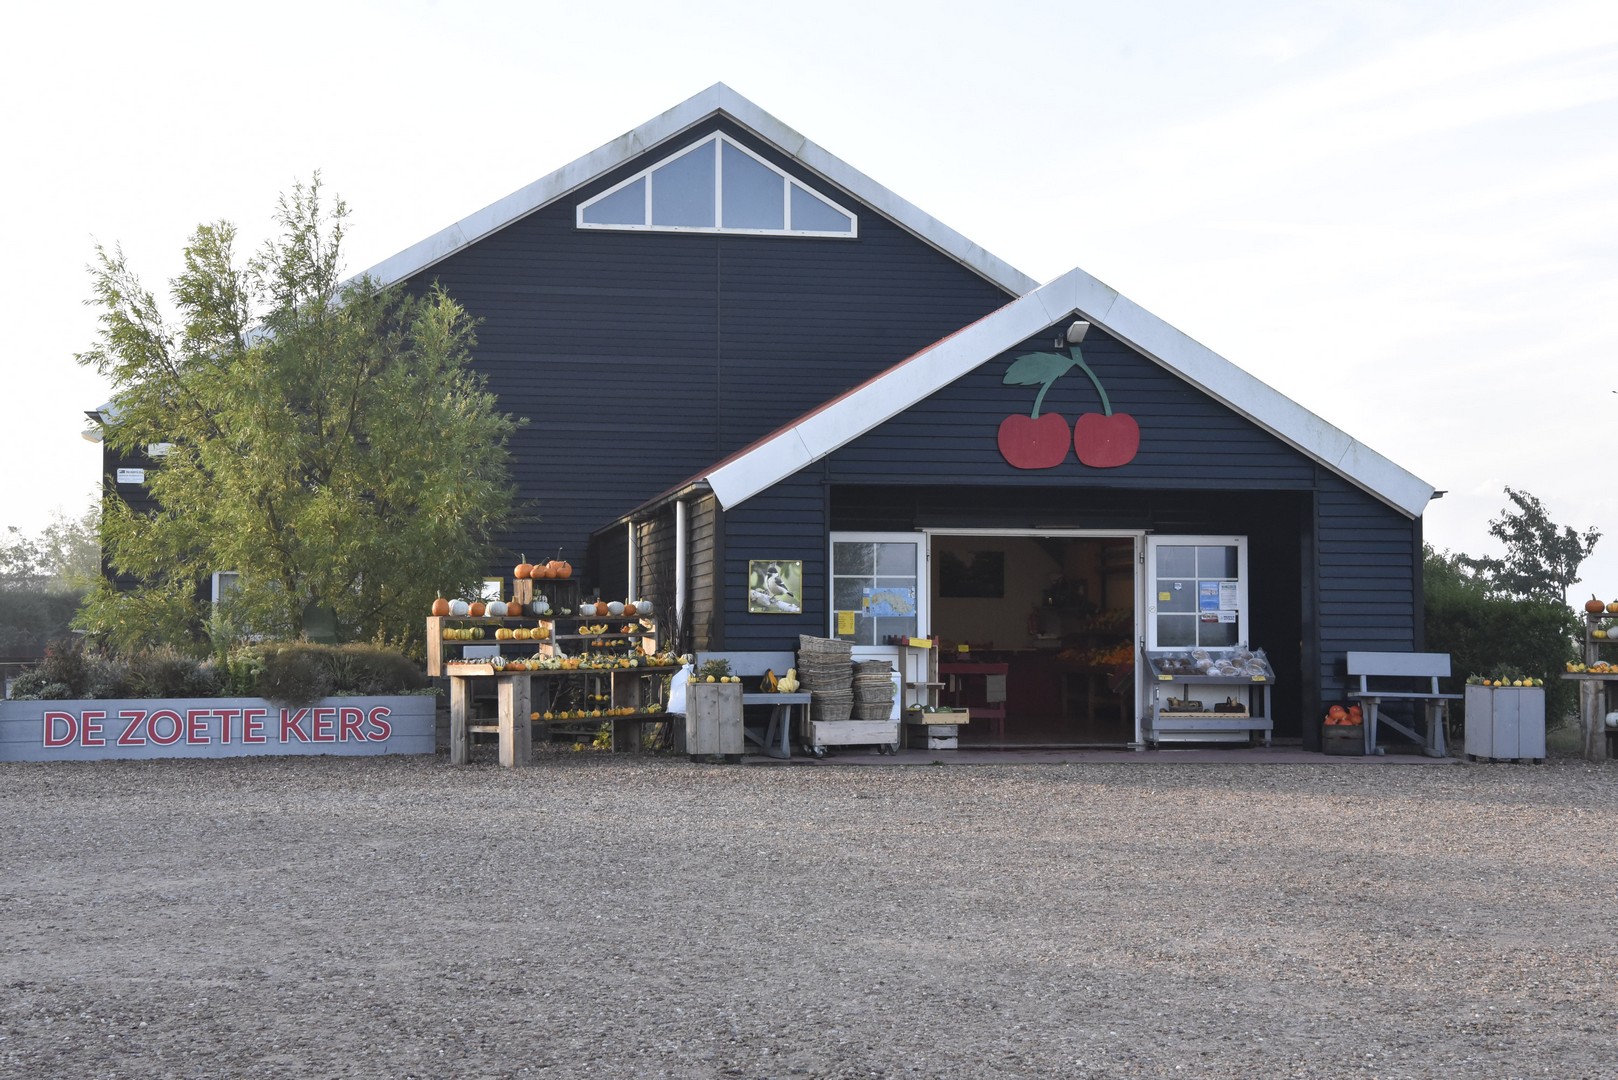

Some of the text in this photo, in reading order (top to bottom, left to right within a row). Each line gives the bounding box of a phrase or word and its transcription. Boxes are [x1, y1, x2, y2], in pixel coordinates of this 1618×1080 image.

[43, 706, 392, 747] DE ZOETE KERS
